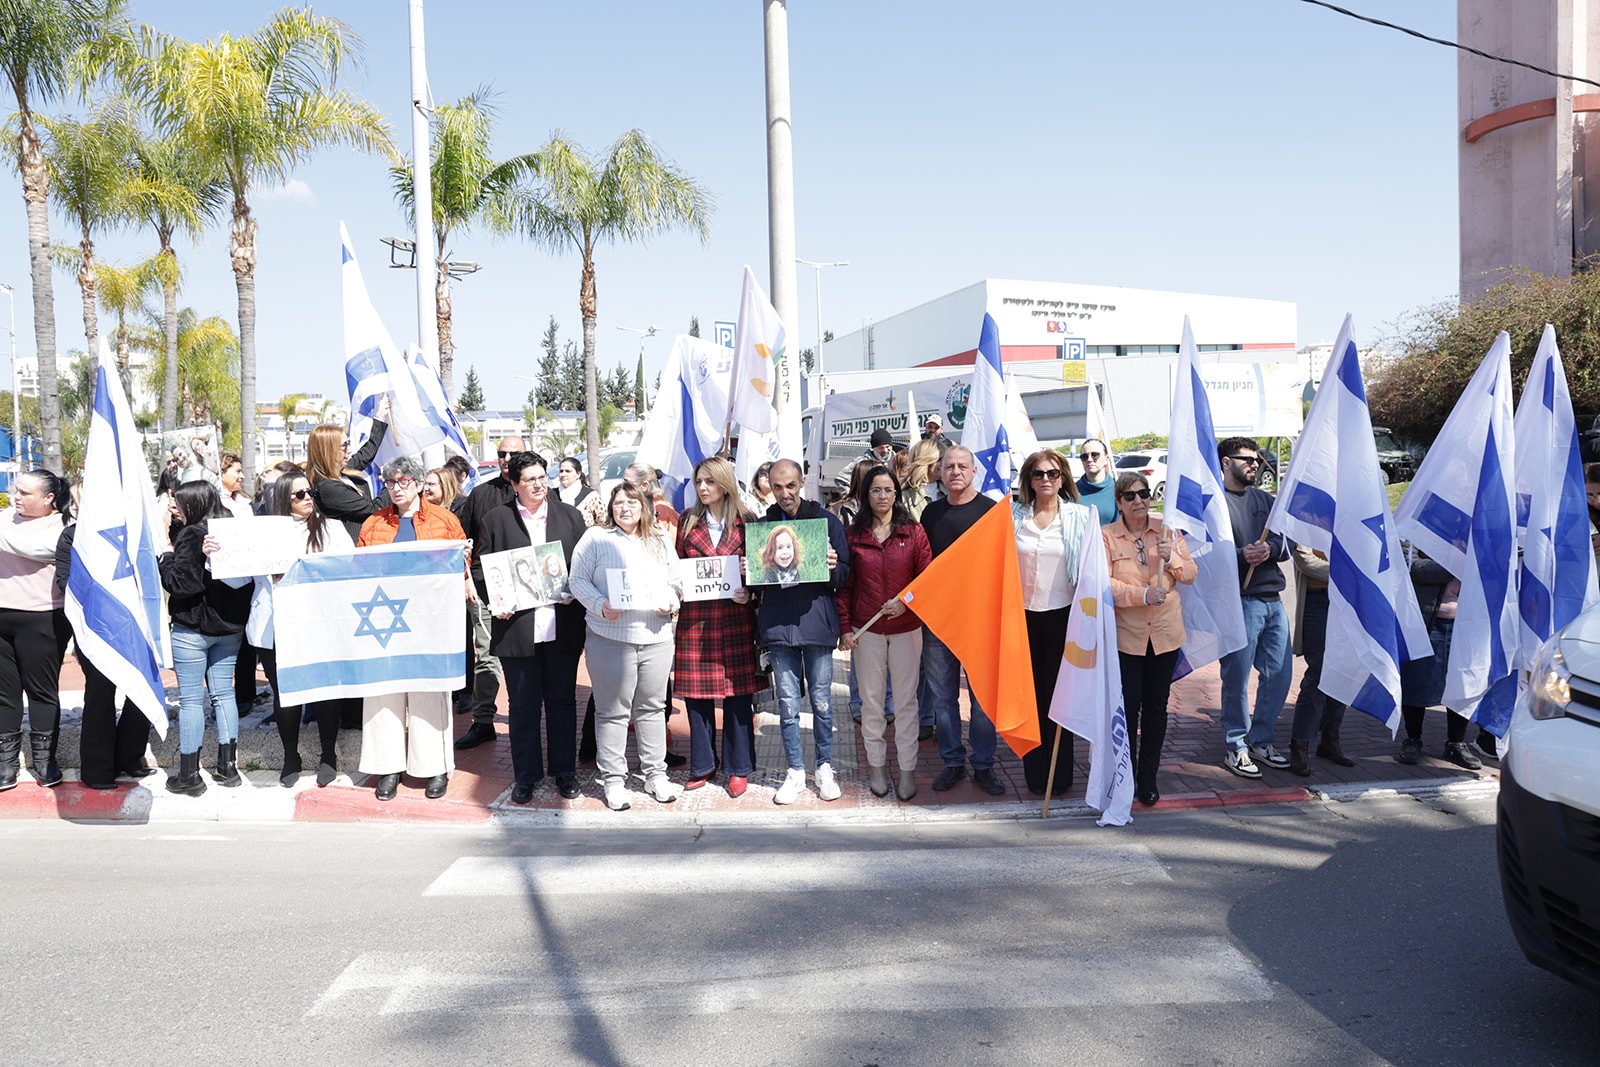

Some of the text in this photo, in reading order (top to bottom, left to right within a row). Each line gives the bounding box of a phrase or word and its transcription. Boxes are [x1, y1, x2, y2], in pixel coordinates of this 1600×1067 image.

[1204, 379, 1254, 392] חניון מגדל
[832, 422, 853, 436] העיר
[855, 420, 869, 434] פני
[871, 413, 908, 431] לשיפור
[694, 580, 731, 593] סליחה
